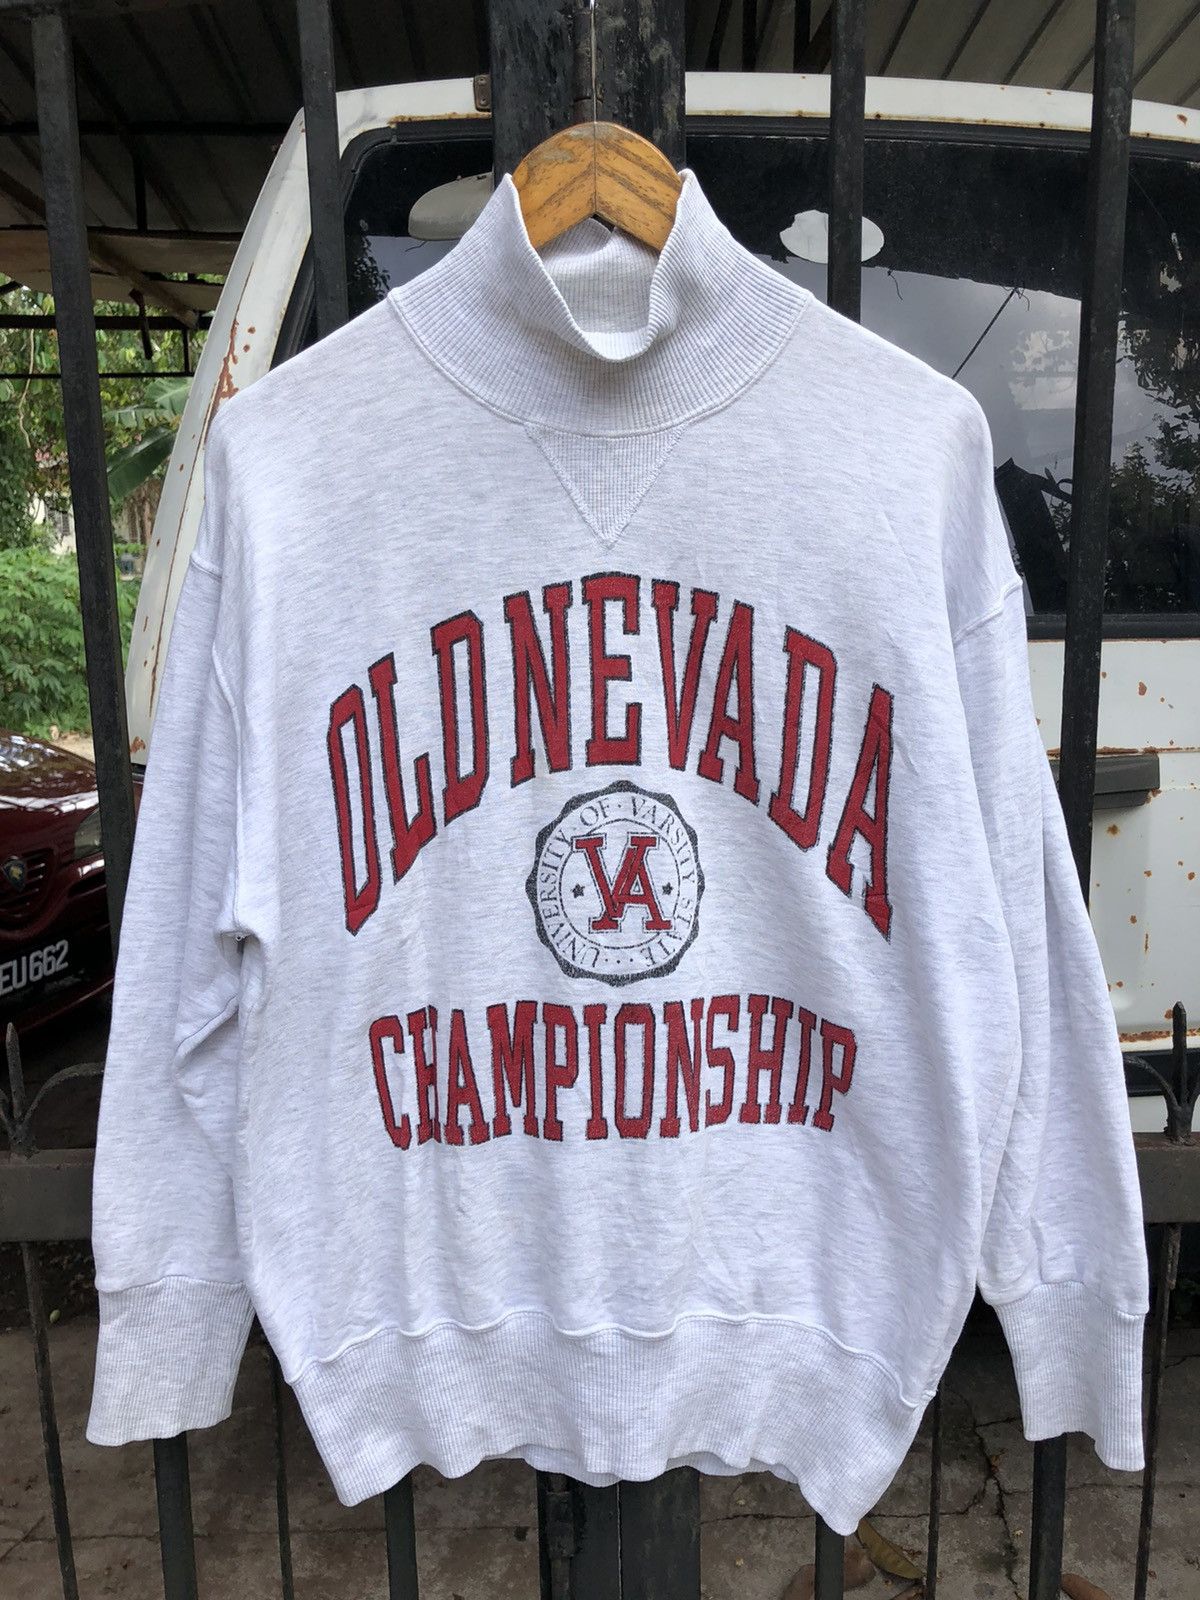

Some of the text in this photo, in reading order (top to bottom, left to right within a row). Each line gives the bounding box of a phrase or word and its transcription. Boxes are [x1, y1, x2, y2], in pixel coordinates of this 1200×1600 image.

[328, 571, 894, 942] OLD NEVADA
[539, 829, 600, 968] UNIVERSITY
[579, 797, 610, 827] OF
[631, 796, 695, 884] VARSITY
[368, 993, 858, 1150] CHAMPIONSHIP
